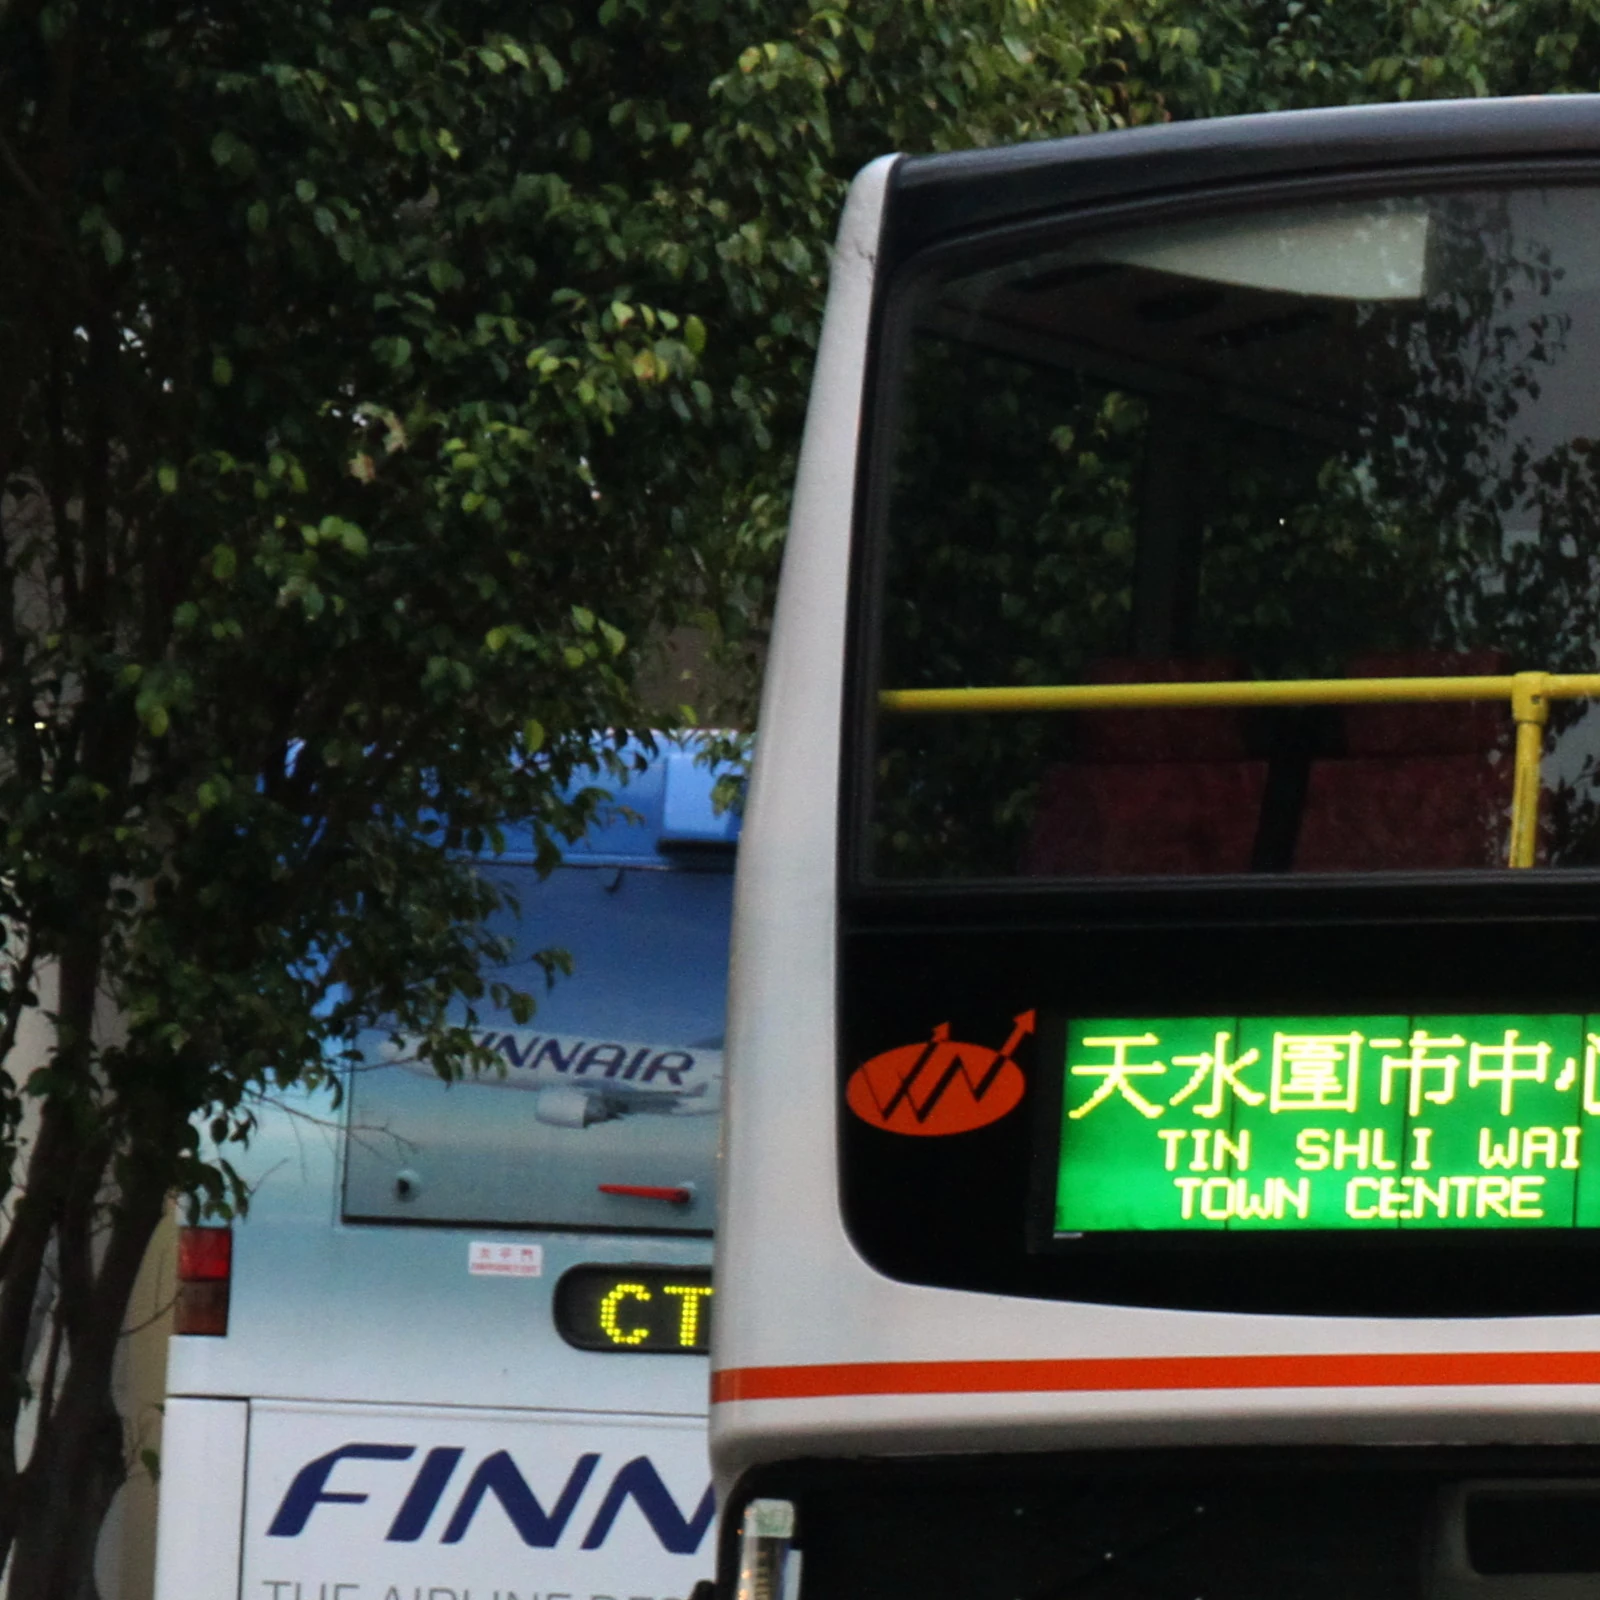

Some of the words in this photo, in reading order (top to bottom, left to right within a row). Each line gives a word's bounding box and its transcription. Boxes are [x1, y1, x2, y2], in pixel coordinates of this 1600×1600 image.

[474, 1031, 695, 1086] INNAIR
[1157, 1128, 1250, 1171] TIN
[1479, 1126, 1582, 1170] WAI
[1173, 1176, 1310, 1220] TOWN
[1345, 1175, 1546, 1219] CENTRE
